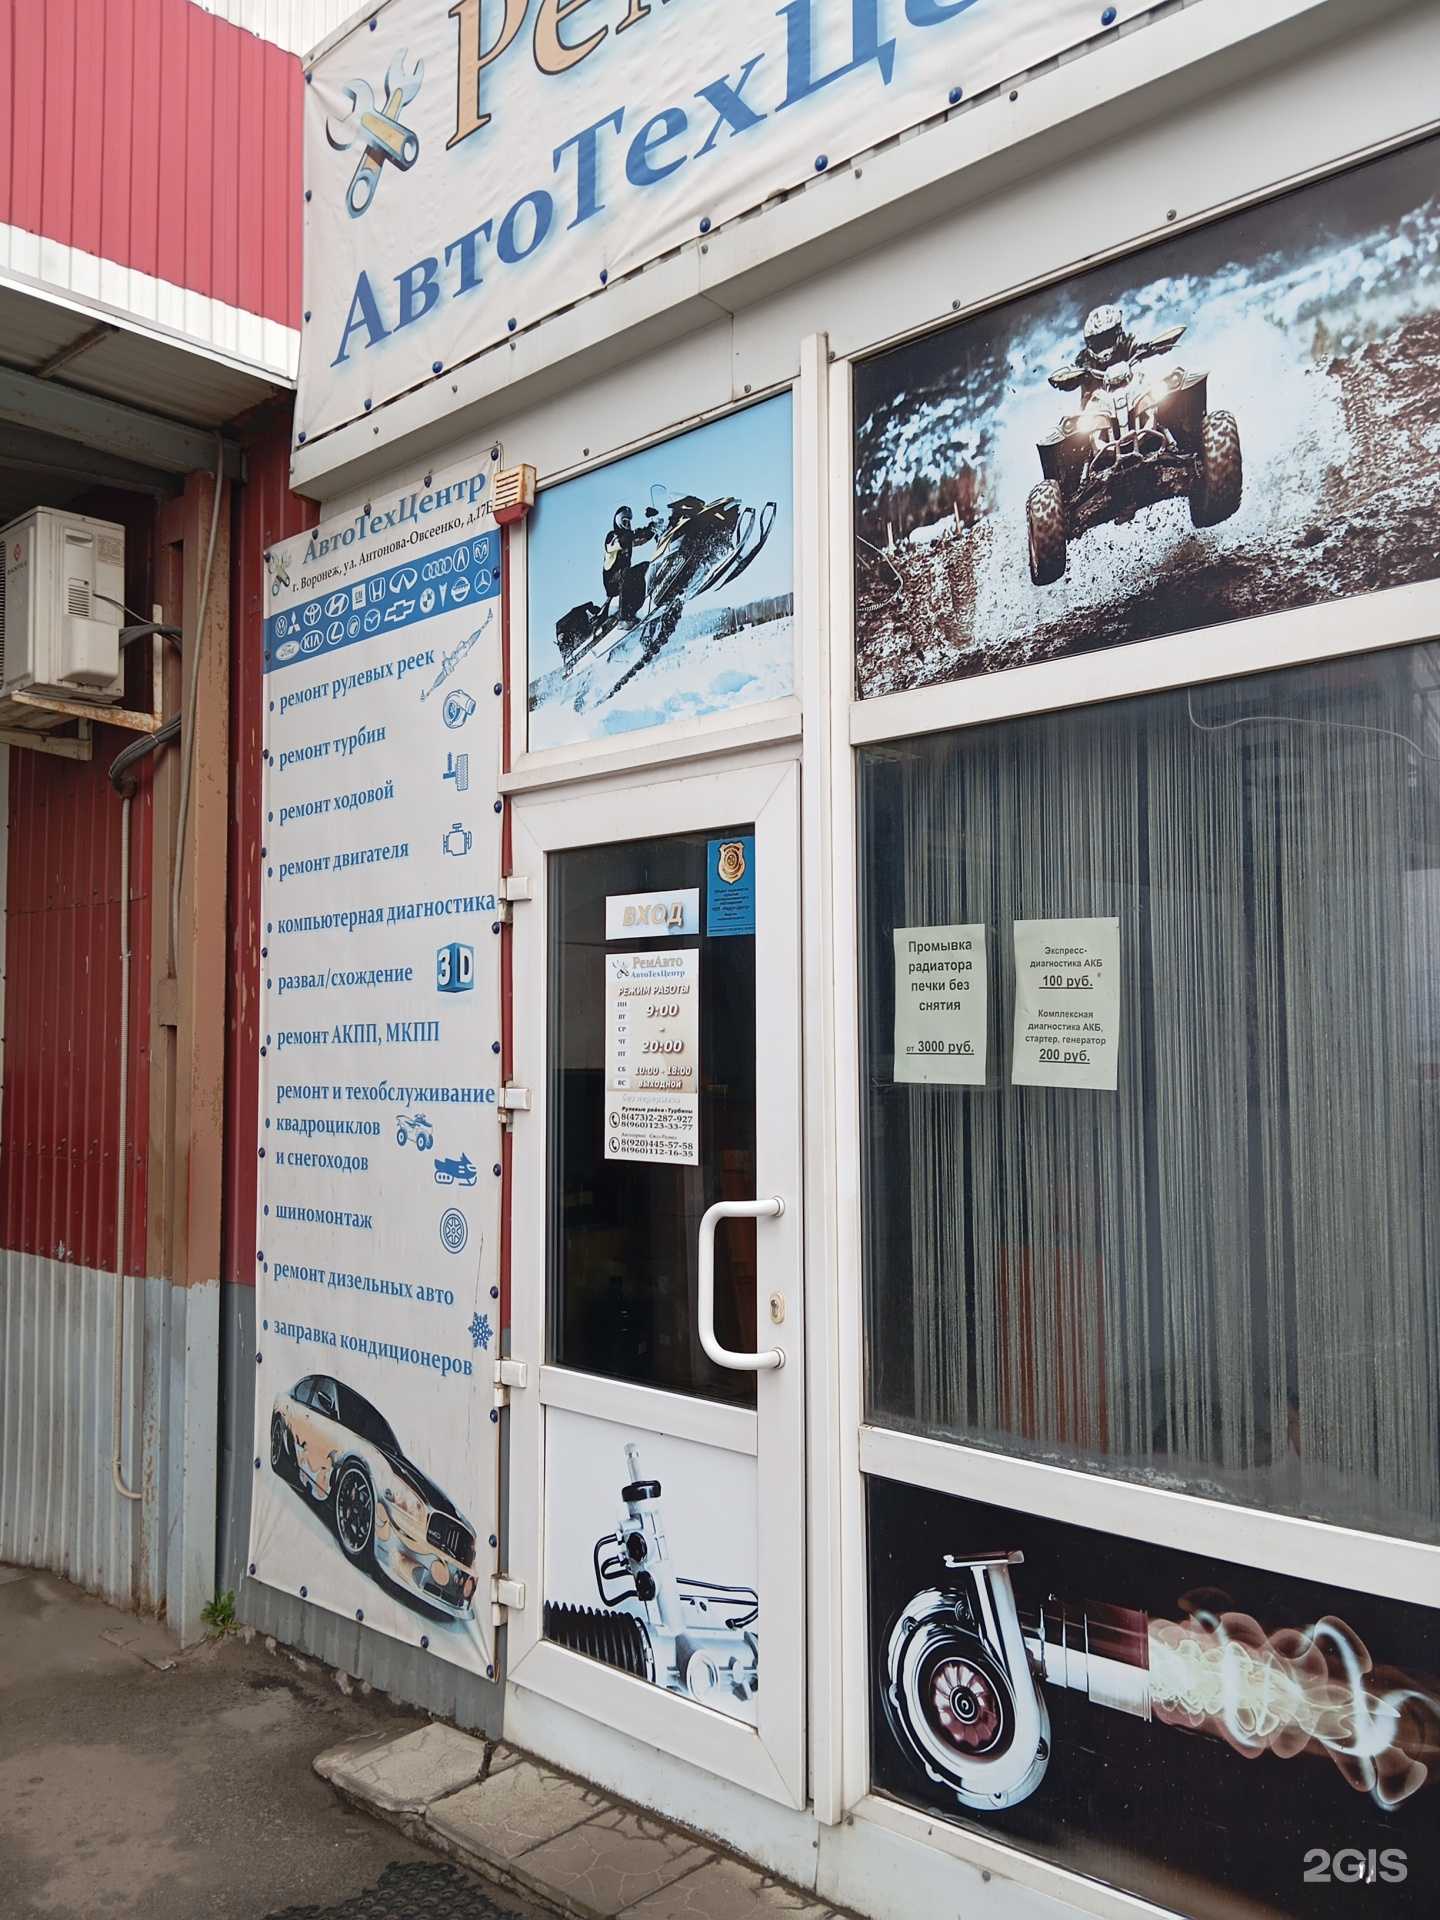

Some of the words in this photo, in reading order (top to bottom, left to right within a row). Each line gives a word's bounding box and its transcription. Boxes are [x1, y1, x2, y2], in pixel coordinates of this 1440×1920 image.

[303, 472, 486, 564] АвтоТехЦентр
[292, 583, 299, 593] г.
[301, 565, 342, 589] Воронеж,
[343, 559, 357, 576] ул.
[359, 518, 464, 566] Антонова-Овсеенко,
[279, 682, 329, 714] ремонт
[332, 662, 394, 698] рулевых
[397, 649, 435, 680] реек
[279, 741, 330, 771] ремонт
[333, 725, 387, 756] турбин
[279, 796, 331, 826] ремонт
[334, 780, 394, 810] ходовой
[279, 856, 331, 882] ремонт
[332, 842, 409, 871] двигателя
[278, 906, 384, 934] компьютерная
[387, 894, 496, 925] диагностика
[623, 902, 684, 928] ВХОД
[908, 940, 973, 955] Промывка
[1044, 946, 1088, 955] Экспресс-
[908, 961, 973, 975] радиатора
[1030, 960, 1082, 968] диагностика
[1084, 959, 1103, 967] АКБ
[278, 966, 414, 995] развал/схождение
[911, 981, 946, 991] печки
[949, 978, 970, 990] без
[1042, 975, 1063, 986] 100
[1066, 974, 1093, 988] руб.
[618, 985, 651, 997] РЕЖИМ
[653, 984, 690, 996] РАБОТЫ
[647, 1004, 680, 1018] 9:00
[919, 1001, 961, 1011] снятия
[1038, 1009, 1094, 1018] Комплексная
[277, 1029, 330, 1050] ремонт
[332, 1022, 383, 1047] АКПП,
[386, 1020, 440, 1043] МКПП
[1027, 1023, 1081, 1031] диагностика
[642, 1040, 684, 1054] 20:00
[918, 1040, 945, 1052] 3000
[948, 1040, 975, 1054] руб.
[1062, 1036, 1106, 1046] генератор
[1039, 1048, 1060, 1060] 200
[1064, 1049, 1091, 1063] руб.
[635, 1065, 660, 1077] 10:00
[667, 1065, 692, 1077] 18:00
[276, 1082, 330, 1103] ремонт
[332, 1084, 342, 1100] и
[345, 1080, 496, 1108] техобслуживание
[276, 1117, 381, 1138] квадроциклов
[276, 1150, 285, 1165] и
[287, 1151, 369, 1172] снегоходов
[276, 1203, 373, 1229] шиномонтаж
[273, 1262, 326, 1283] ремонт
[328, 1270, 413, 1298] дизельных
[416, 1285, 454, 1305] авто
[273, 1319, 337, 1346] заправка
[340, 1333, 473, 1377] кондиционеров
